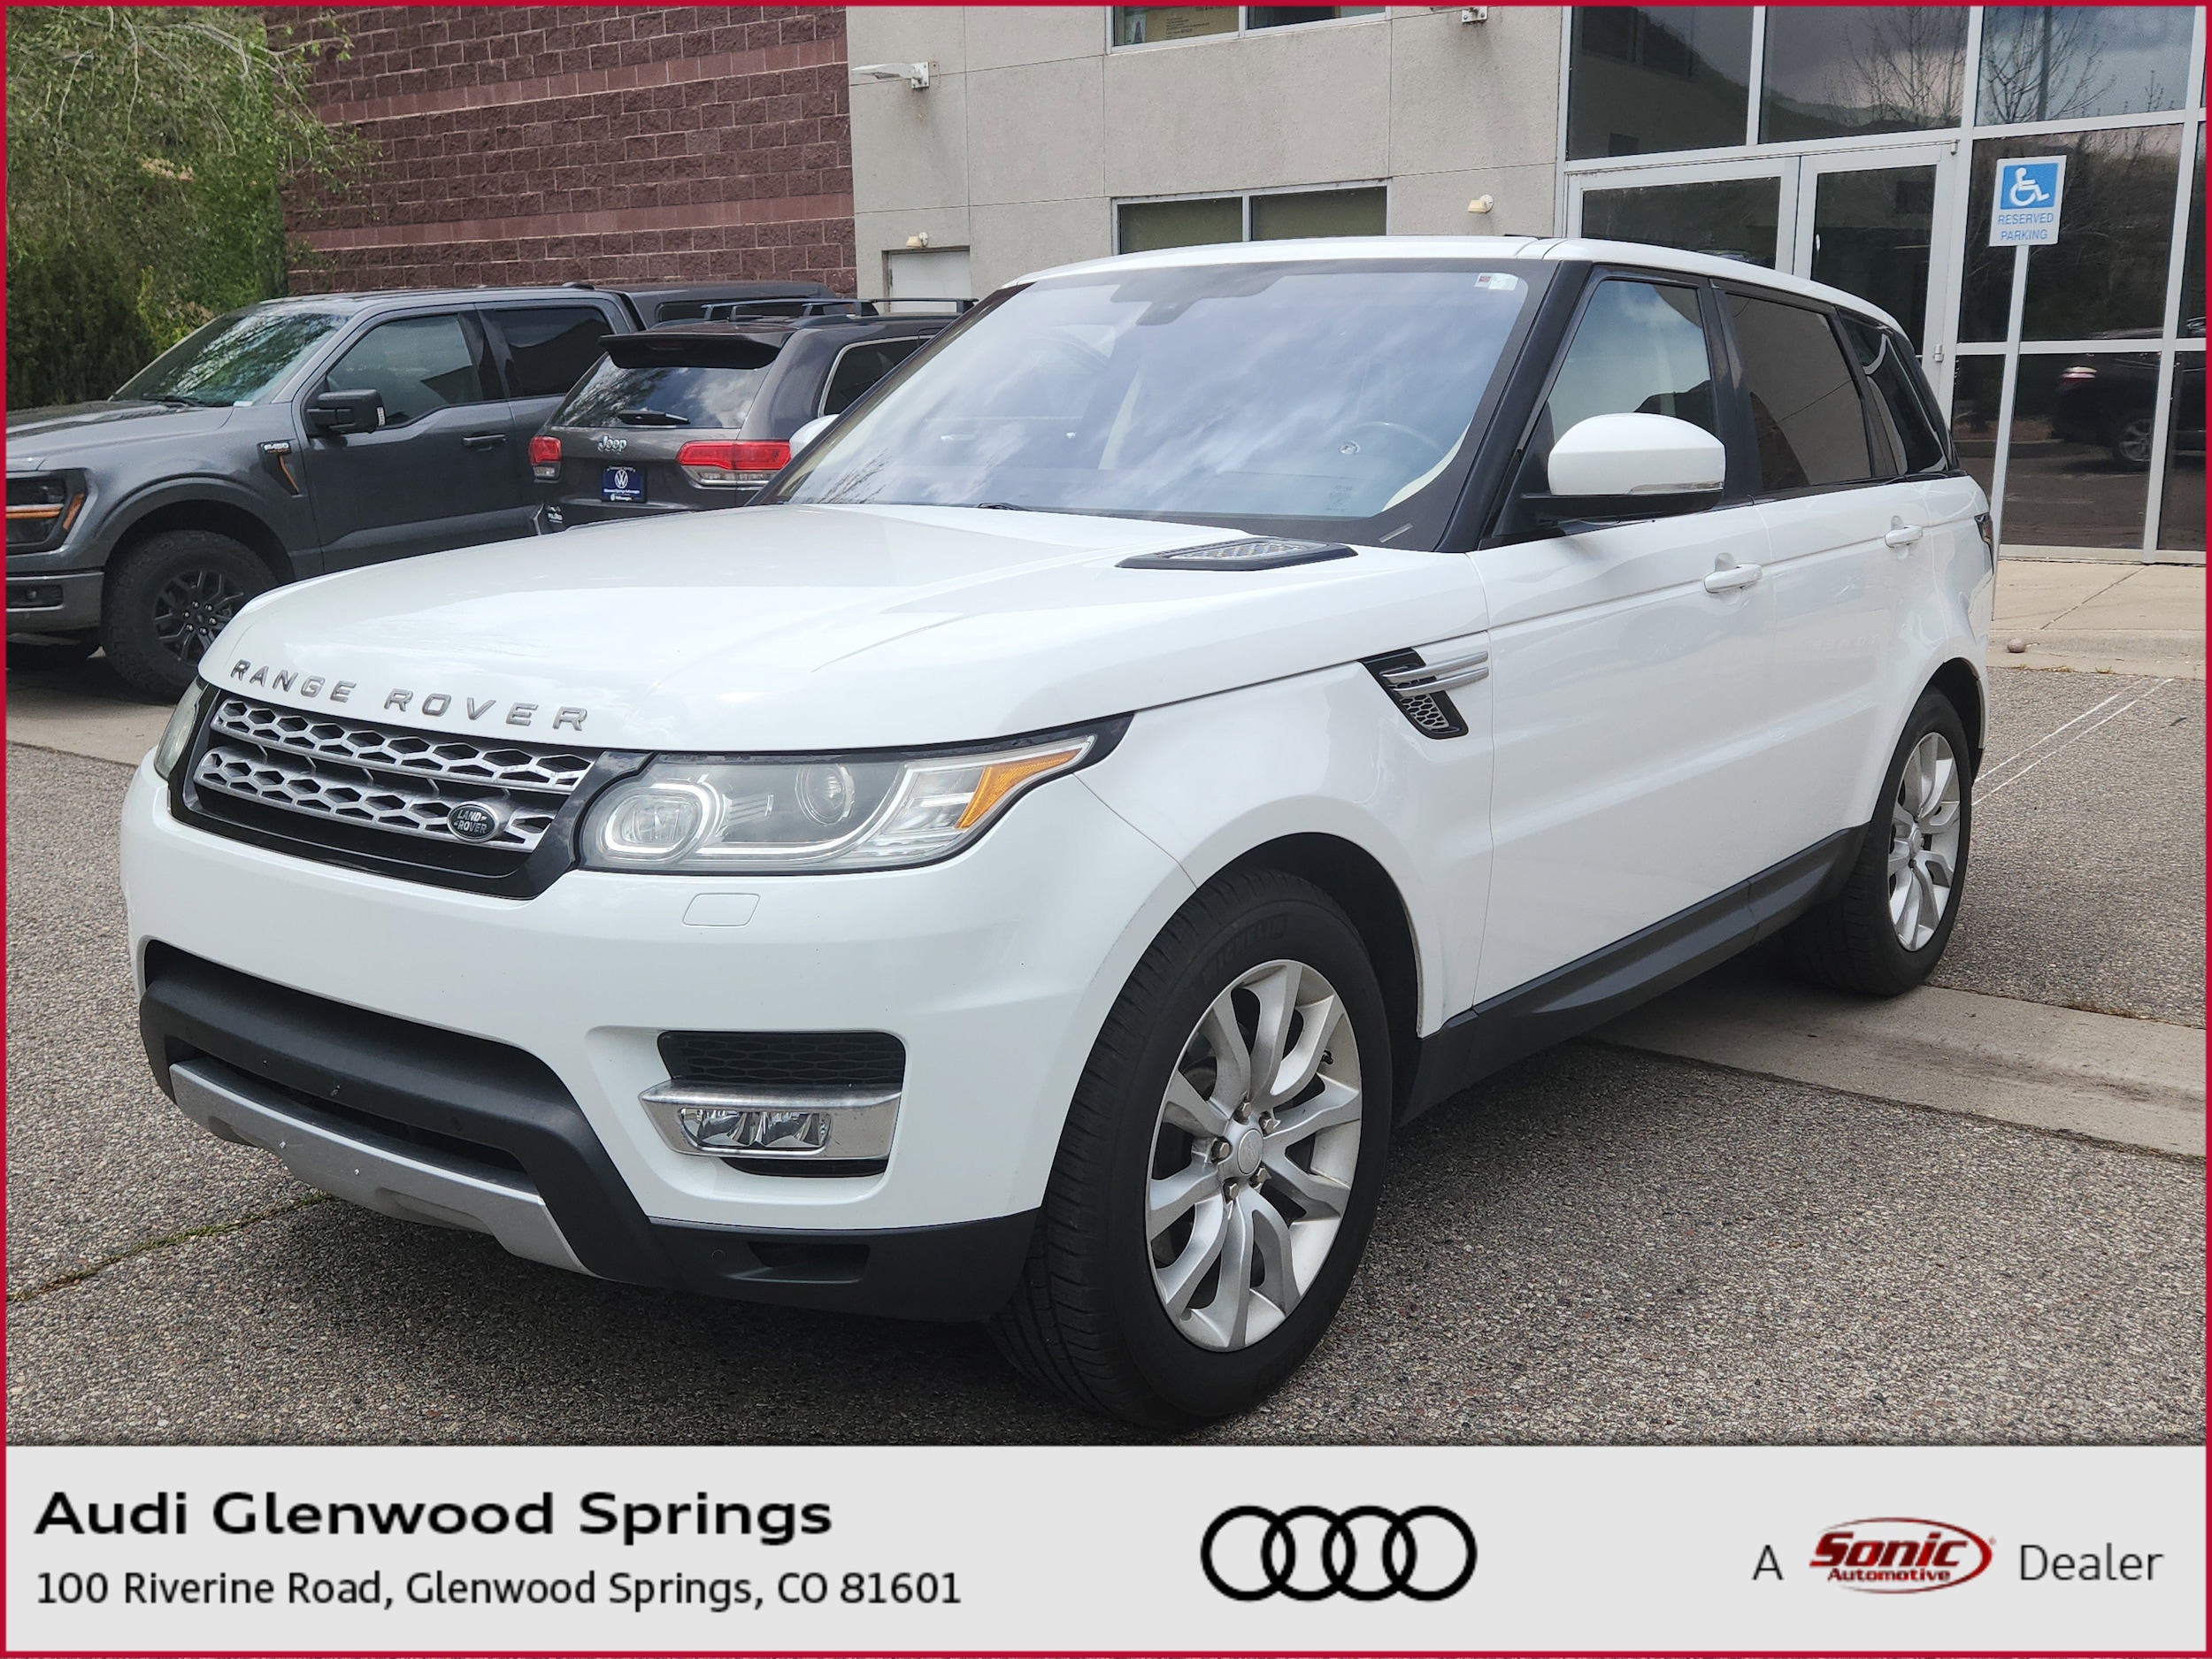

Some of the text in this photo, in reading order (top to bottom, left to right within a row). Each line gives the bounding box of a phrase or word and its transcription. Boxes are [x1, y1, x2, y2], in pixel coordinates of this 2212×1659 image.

[1999, 213, 2054, 225] RESERVED
[2001, 230, 2047, 240] PARKING
[598, 435, 627, 451] Jeep
[230, 659, 588, 732] RANGE ROVER
[457, 809, 482, 822] LAND
[457, 819, 488, 834] ROVER
